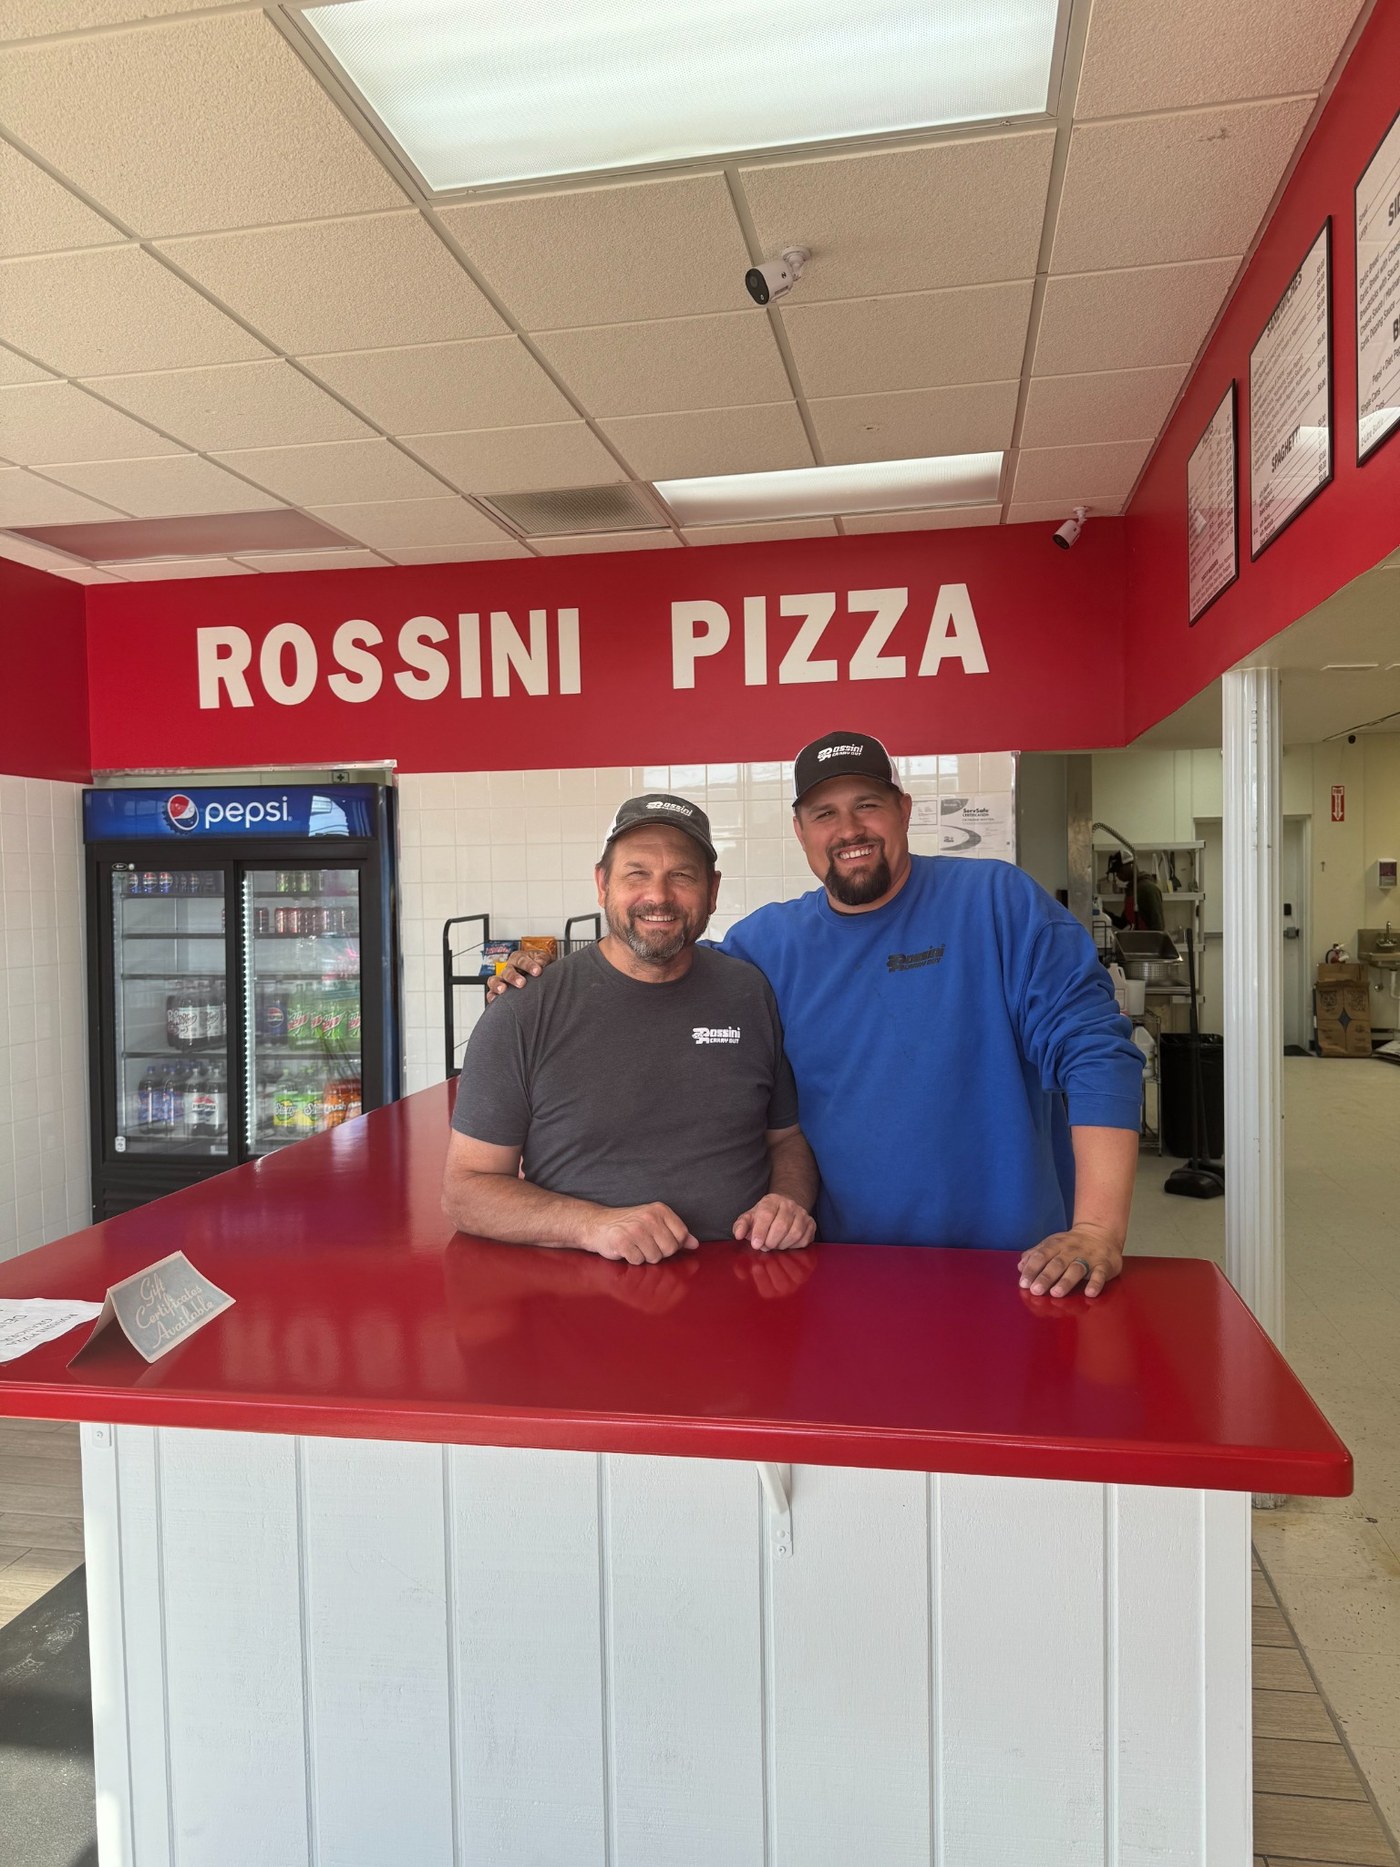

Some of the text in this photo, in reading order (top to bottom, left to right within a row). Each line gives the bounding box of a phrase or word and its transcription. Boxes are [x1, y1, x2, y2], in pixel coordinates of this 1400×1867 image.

[197, 583, 990, 709] ROSSINI PIZZA
[817, 743, 864, 762] Rossini
[205, 796, 288, 829] pepsi
[646, 801, 693, 817] Rossini
[692, 1026, 740, 1044] Rossini
[140, 1272, 166, 1307] Gift
[136, 1286, 202, 1329] Certificates
[153, 1294, 214, 1349] Available
